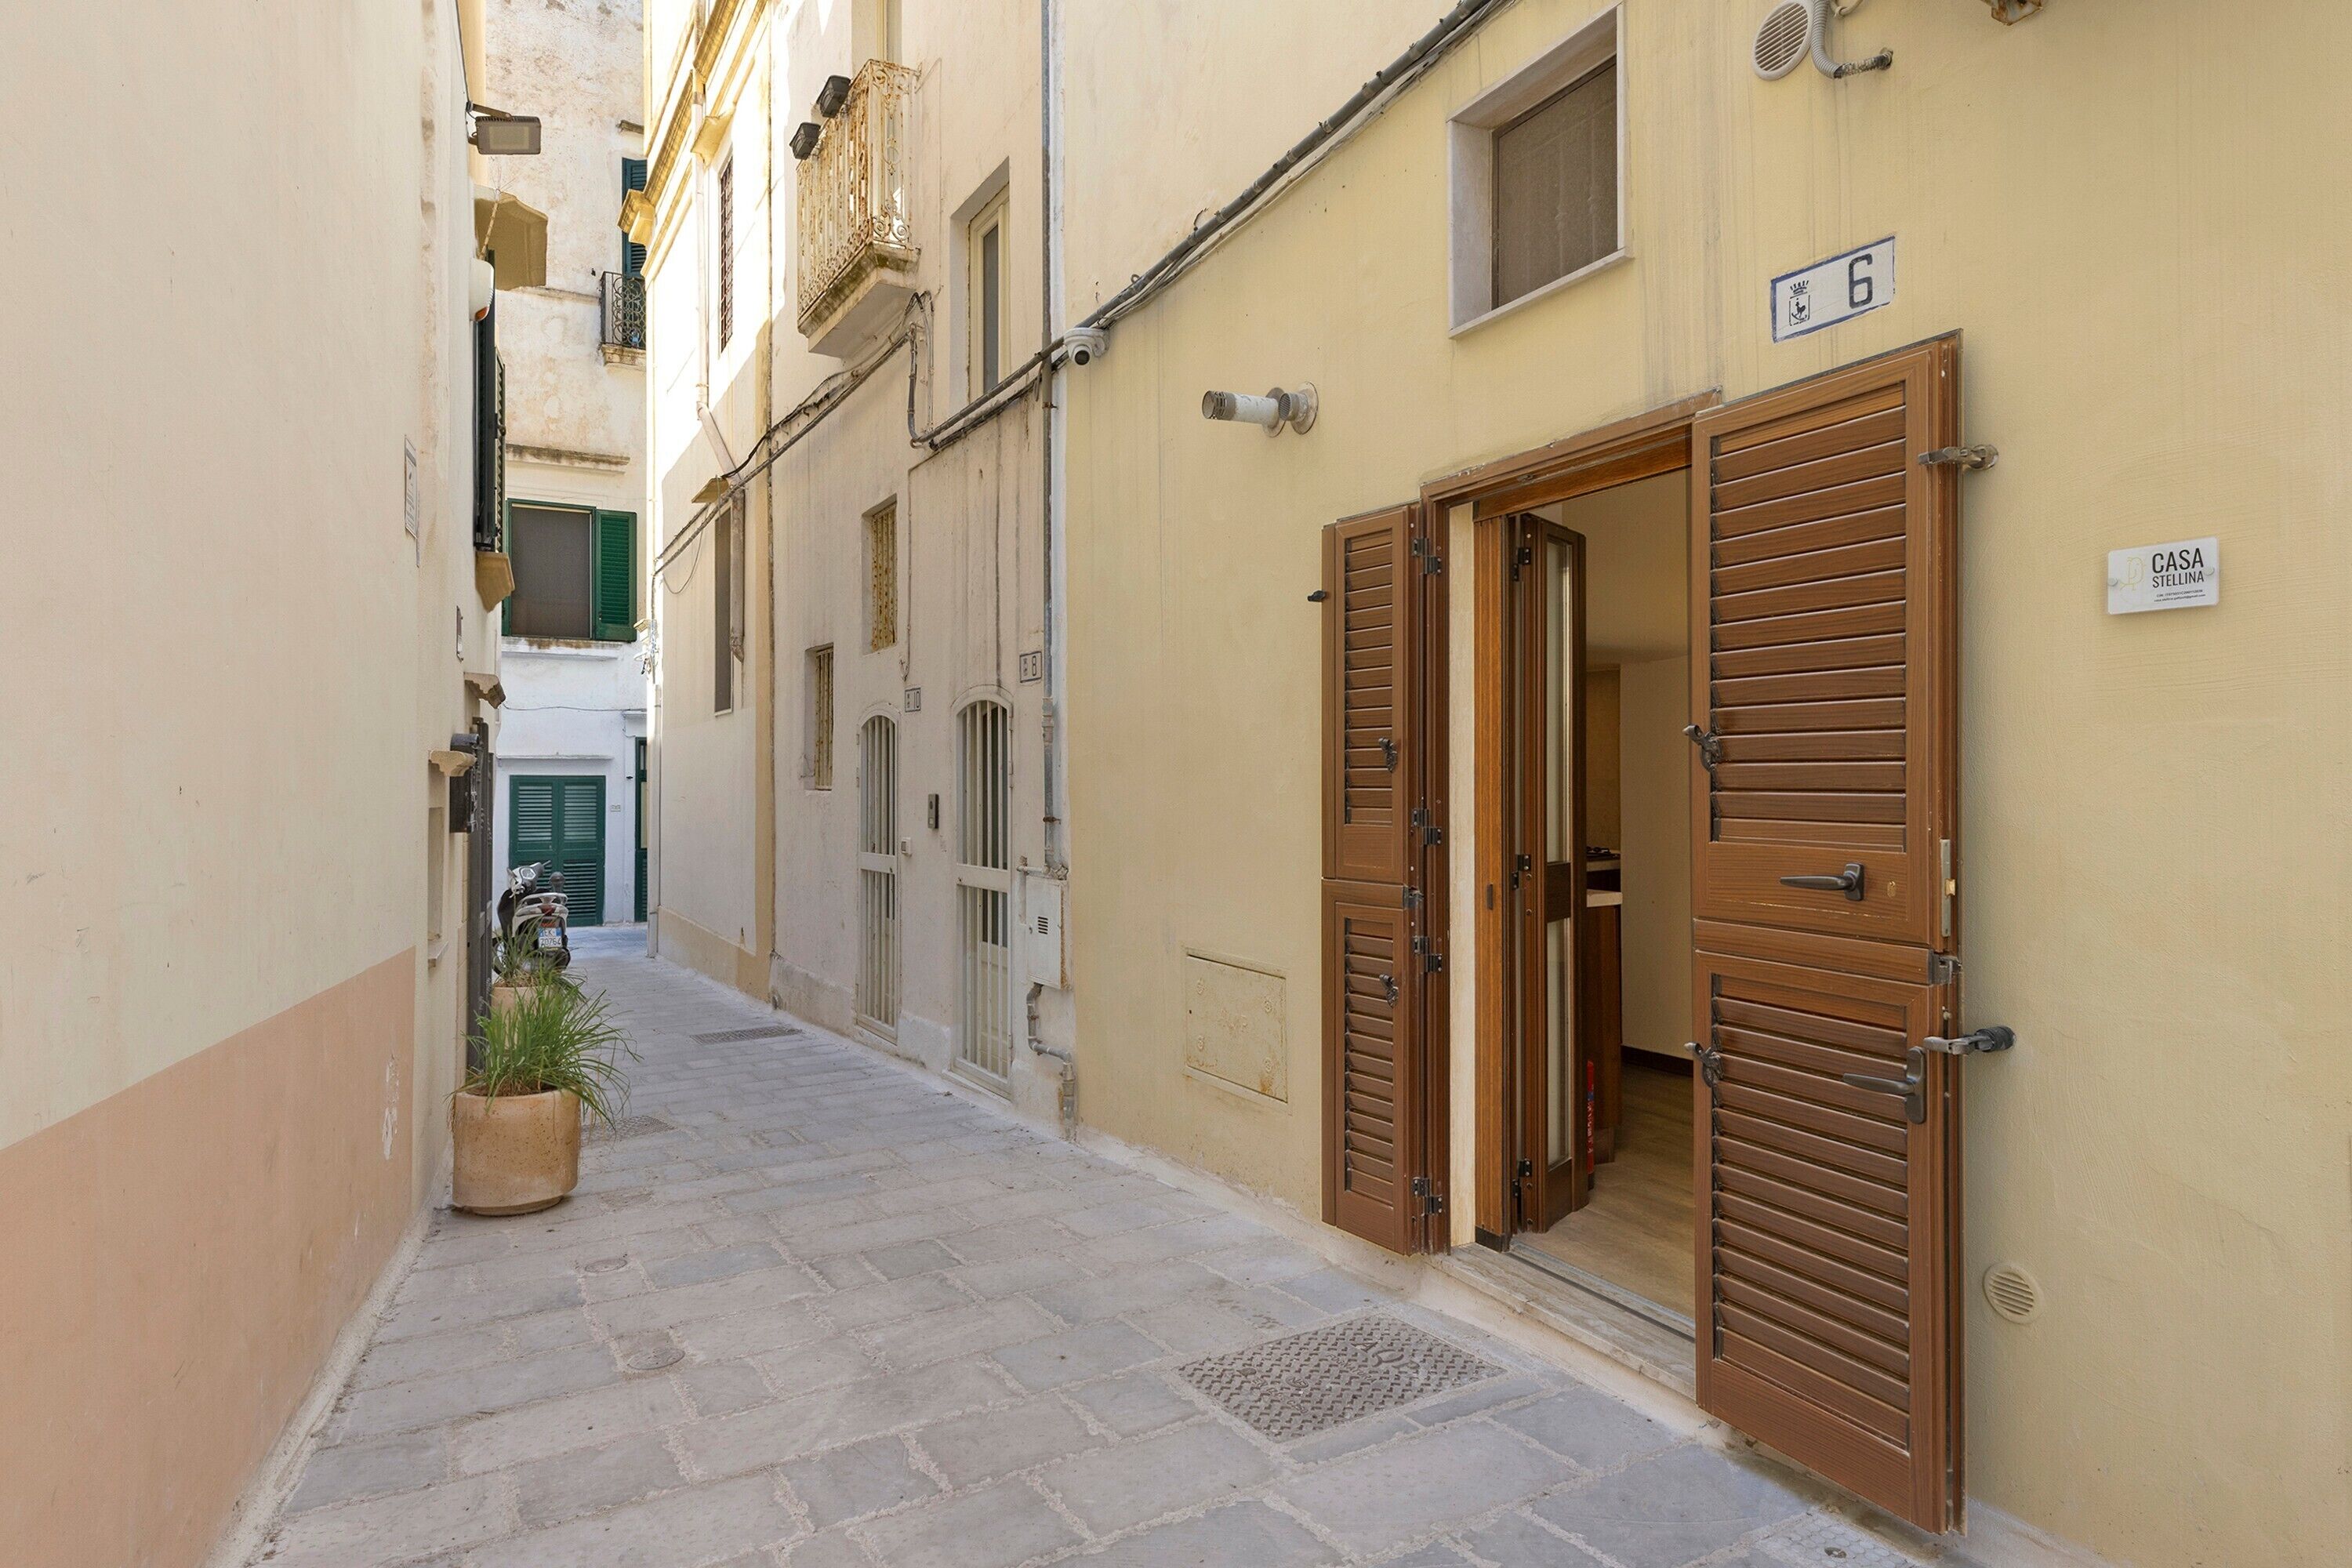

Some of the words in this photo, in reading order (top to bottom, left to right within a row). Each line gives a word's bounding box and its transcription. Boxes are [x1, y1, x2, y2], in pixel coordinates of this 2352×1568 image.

[1849, 253, 1873, 310] 6
[2152, 547, 2204, 574] CASA
[2152, 571, 2205, 588] STELLINA
[1032, 655, 1037, 677] 8
[1350, 1341, 1421, 1369] AQP
